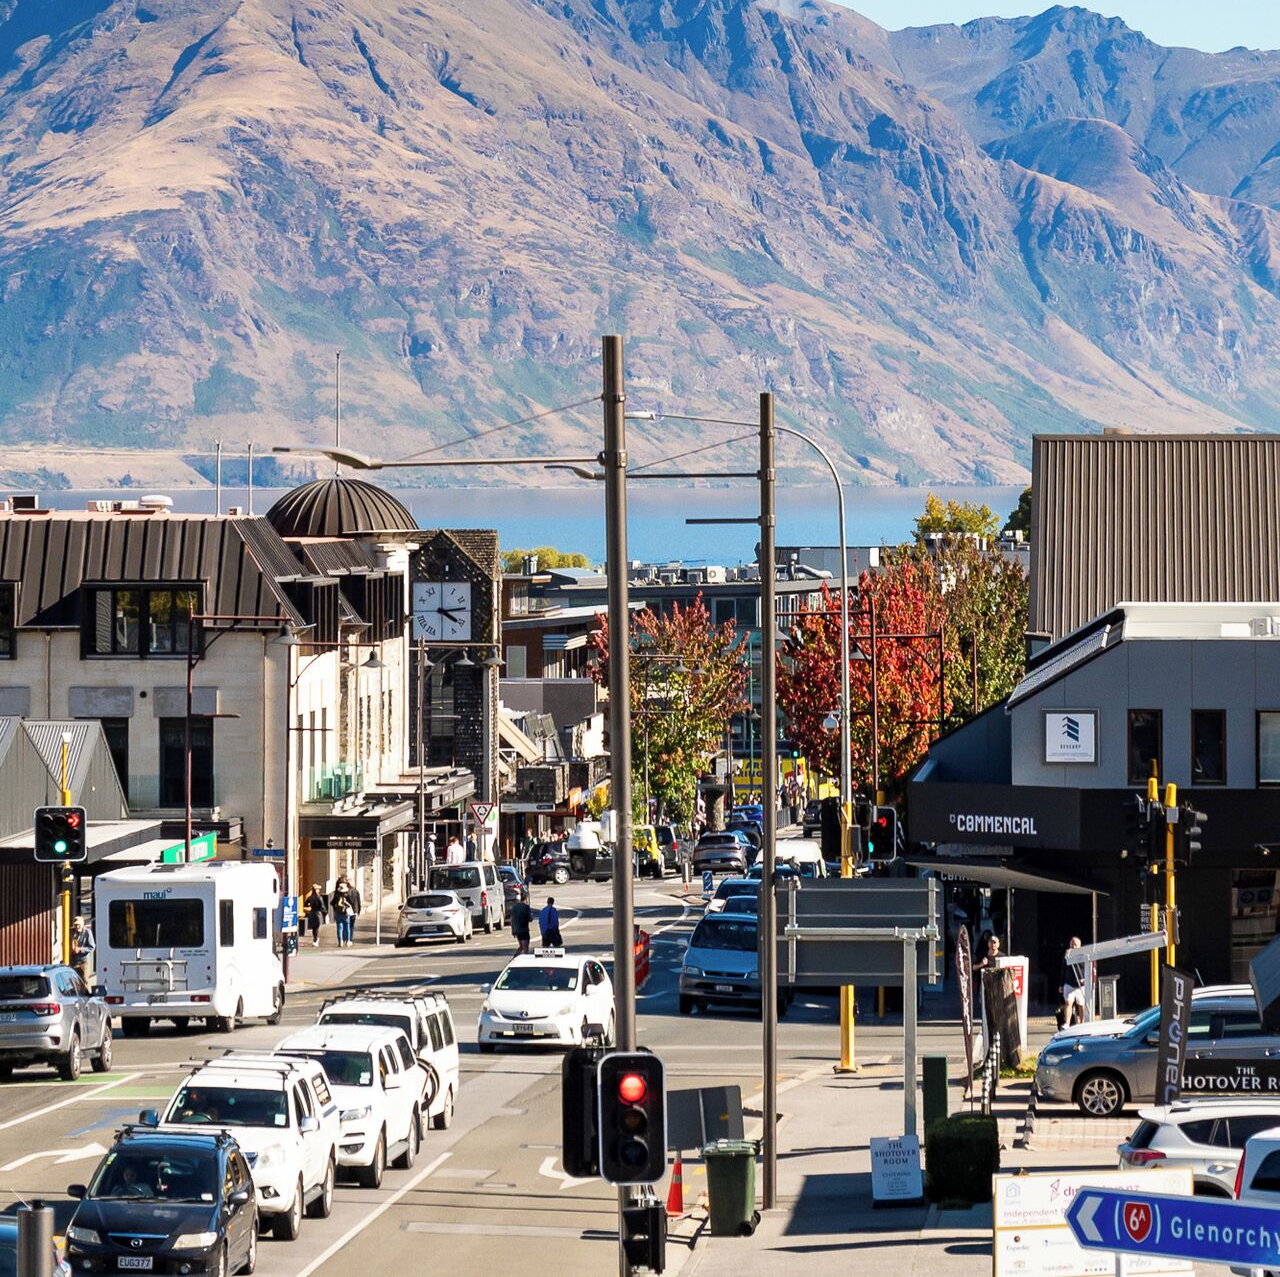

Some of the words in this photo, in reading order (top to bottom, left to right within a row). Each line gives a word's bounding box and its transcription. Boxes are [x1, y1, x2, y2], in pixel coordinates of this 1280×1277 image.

[957, 814, 1037, 835] COMMENCAL
[143, 889, 166, 900] maui
[1236, 1066, 1256, 1075] THE
[1181, 1075, 1262, 1090] HOTOVER
[874, 1149, 917, 1157] SHOTOVER
[883, 1157, 909, 1165] ROOM
[1003, 1207, 1058, 1220] Independent
[1129, 1208, 1146, 1231] 6A
